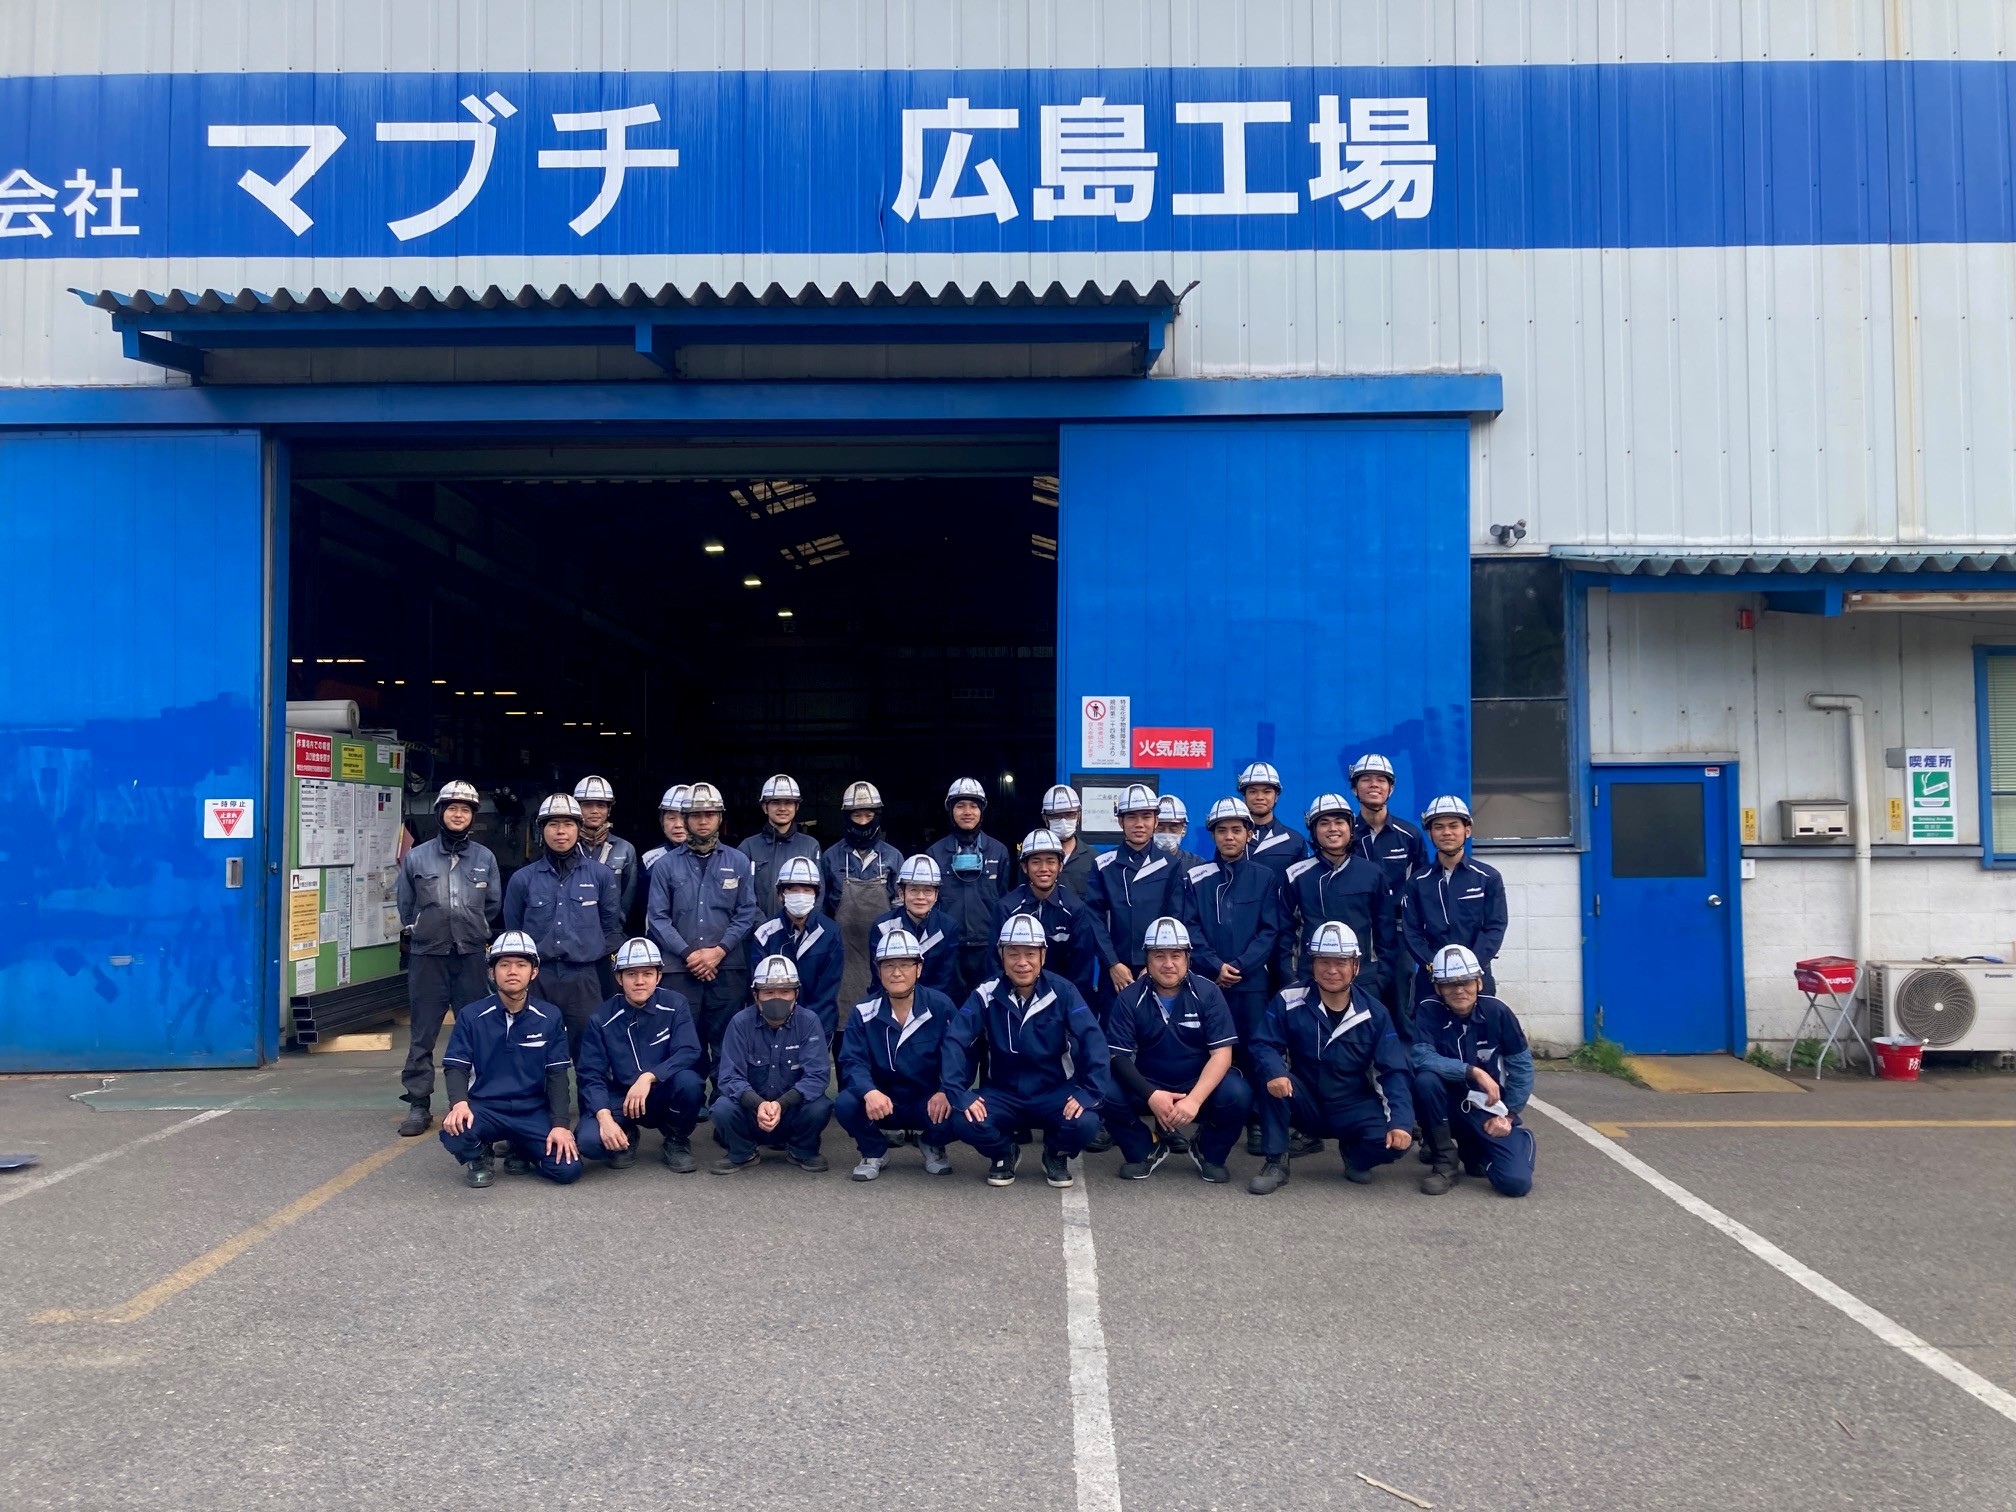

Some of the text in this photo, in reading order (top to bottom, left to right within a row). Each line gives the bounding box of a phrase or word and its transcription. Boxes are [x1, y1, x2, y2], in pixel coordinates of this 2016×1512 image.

[0, 91, 1437, 241] 会社 マブチ 広島工場
[1139, 740, 1207, 757] 火気厳禁
[1909, 755, 1952, 768] 喫煙所
